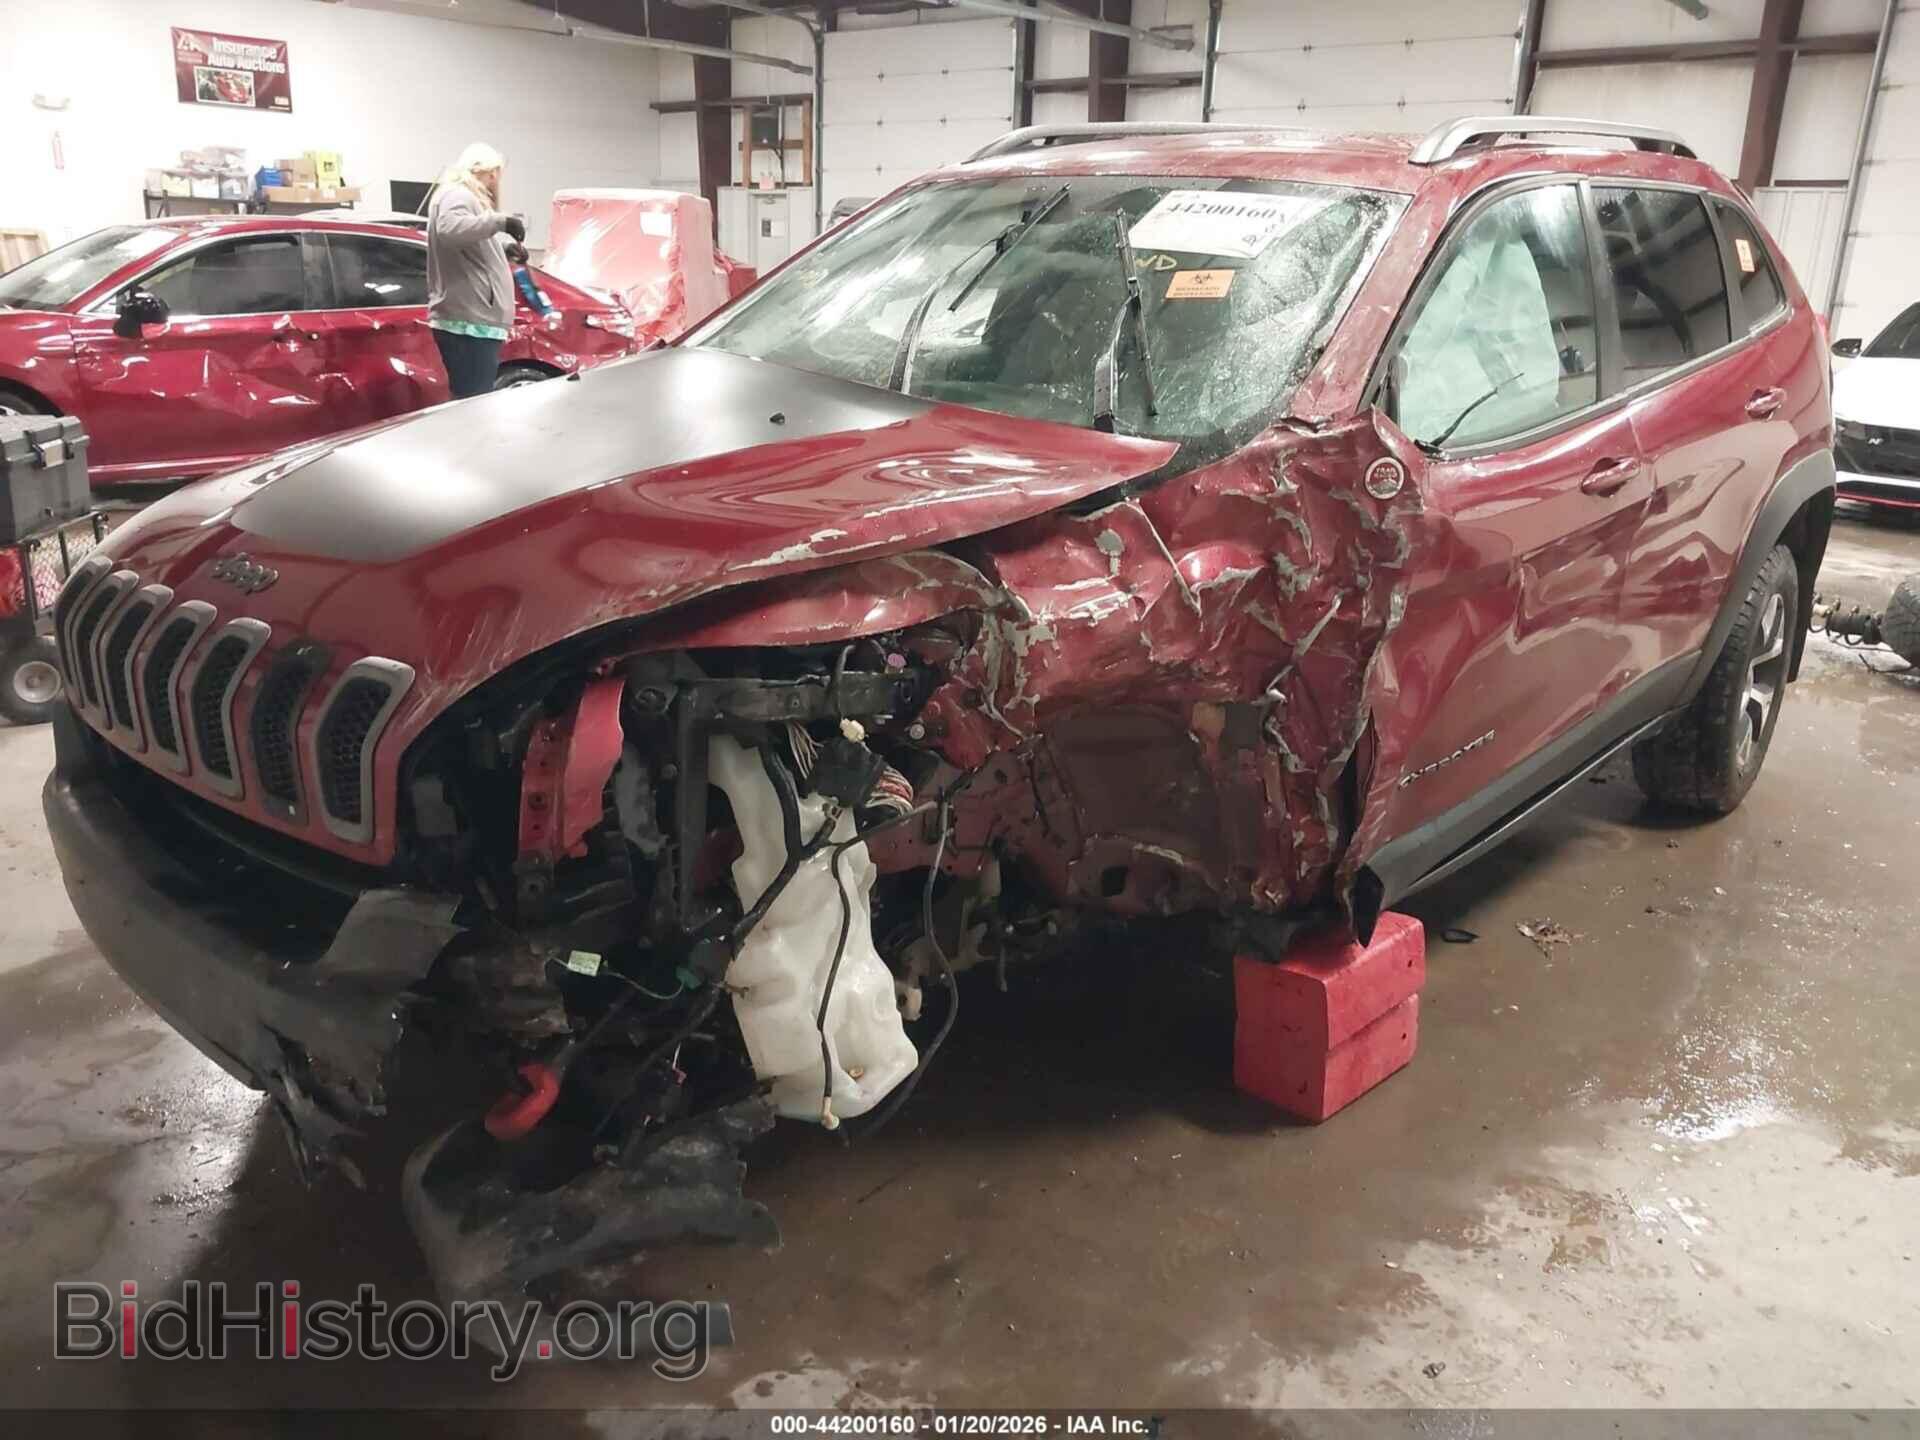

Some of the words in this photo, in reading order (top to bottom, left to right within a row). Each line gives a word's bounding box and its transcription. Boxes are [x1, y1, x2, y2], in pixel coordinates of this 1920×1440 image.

[213, 38, 276, 58] Insurance
[208, 54, 235, 69] Auto
[237, 58, 285, 73] Auctions
[1167, 203, 1276, 219] 44200160
